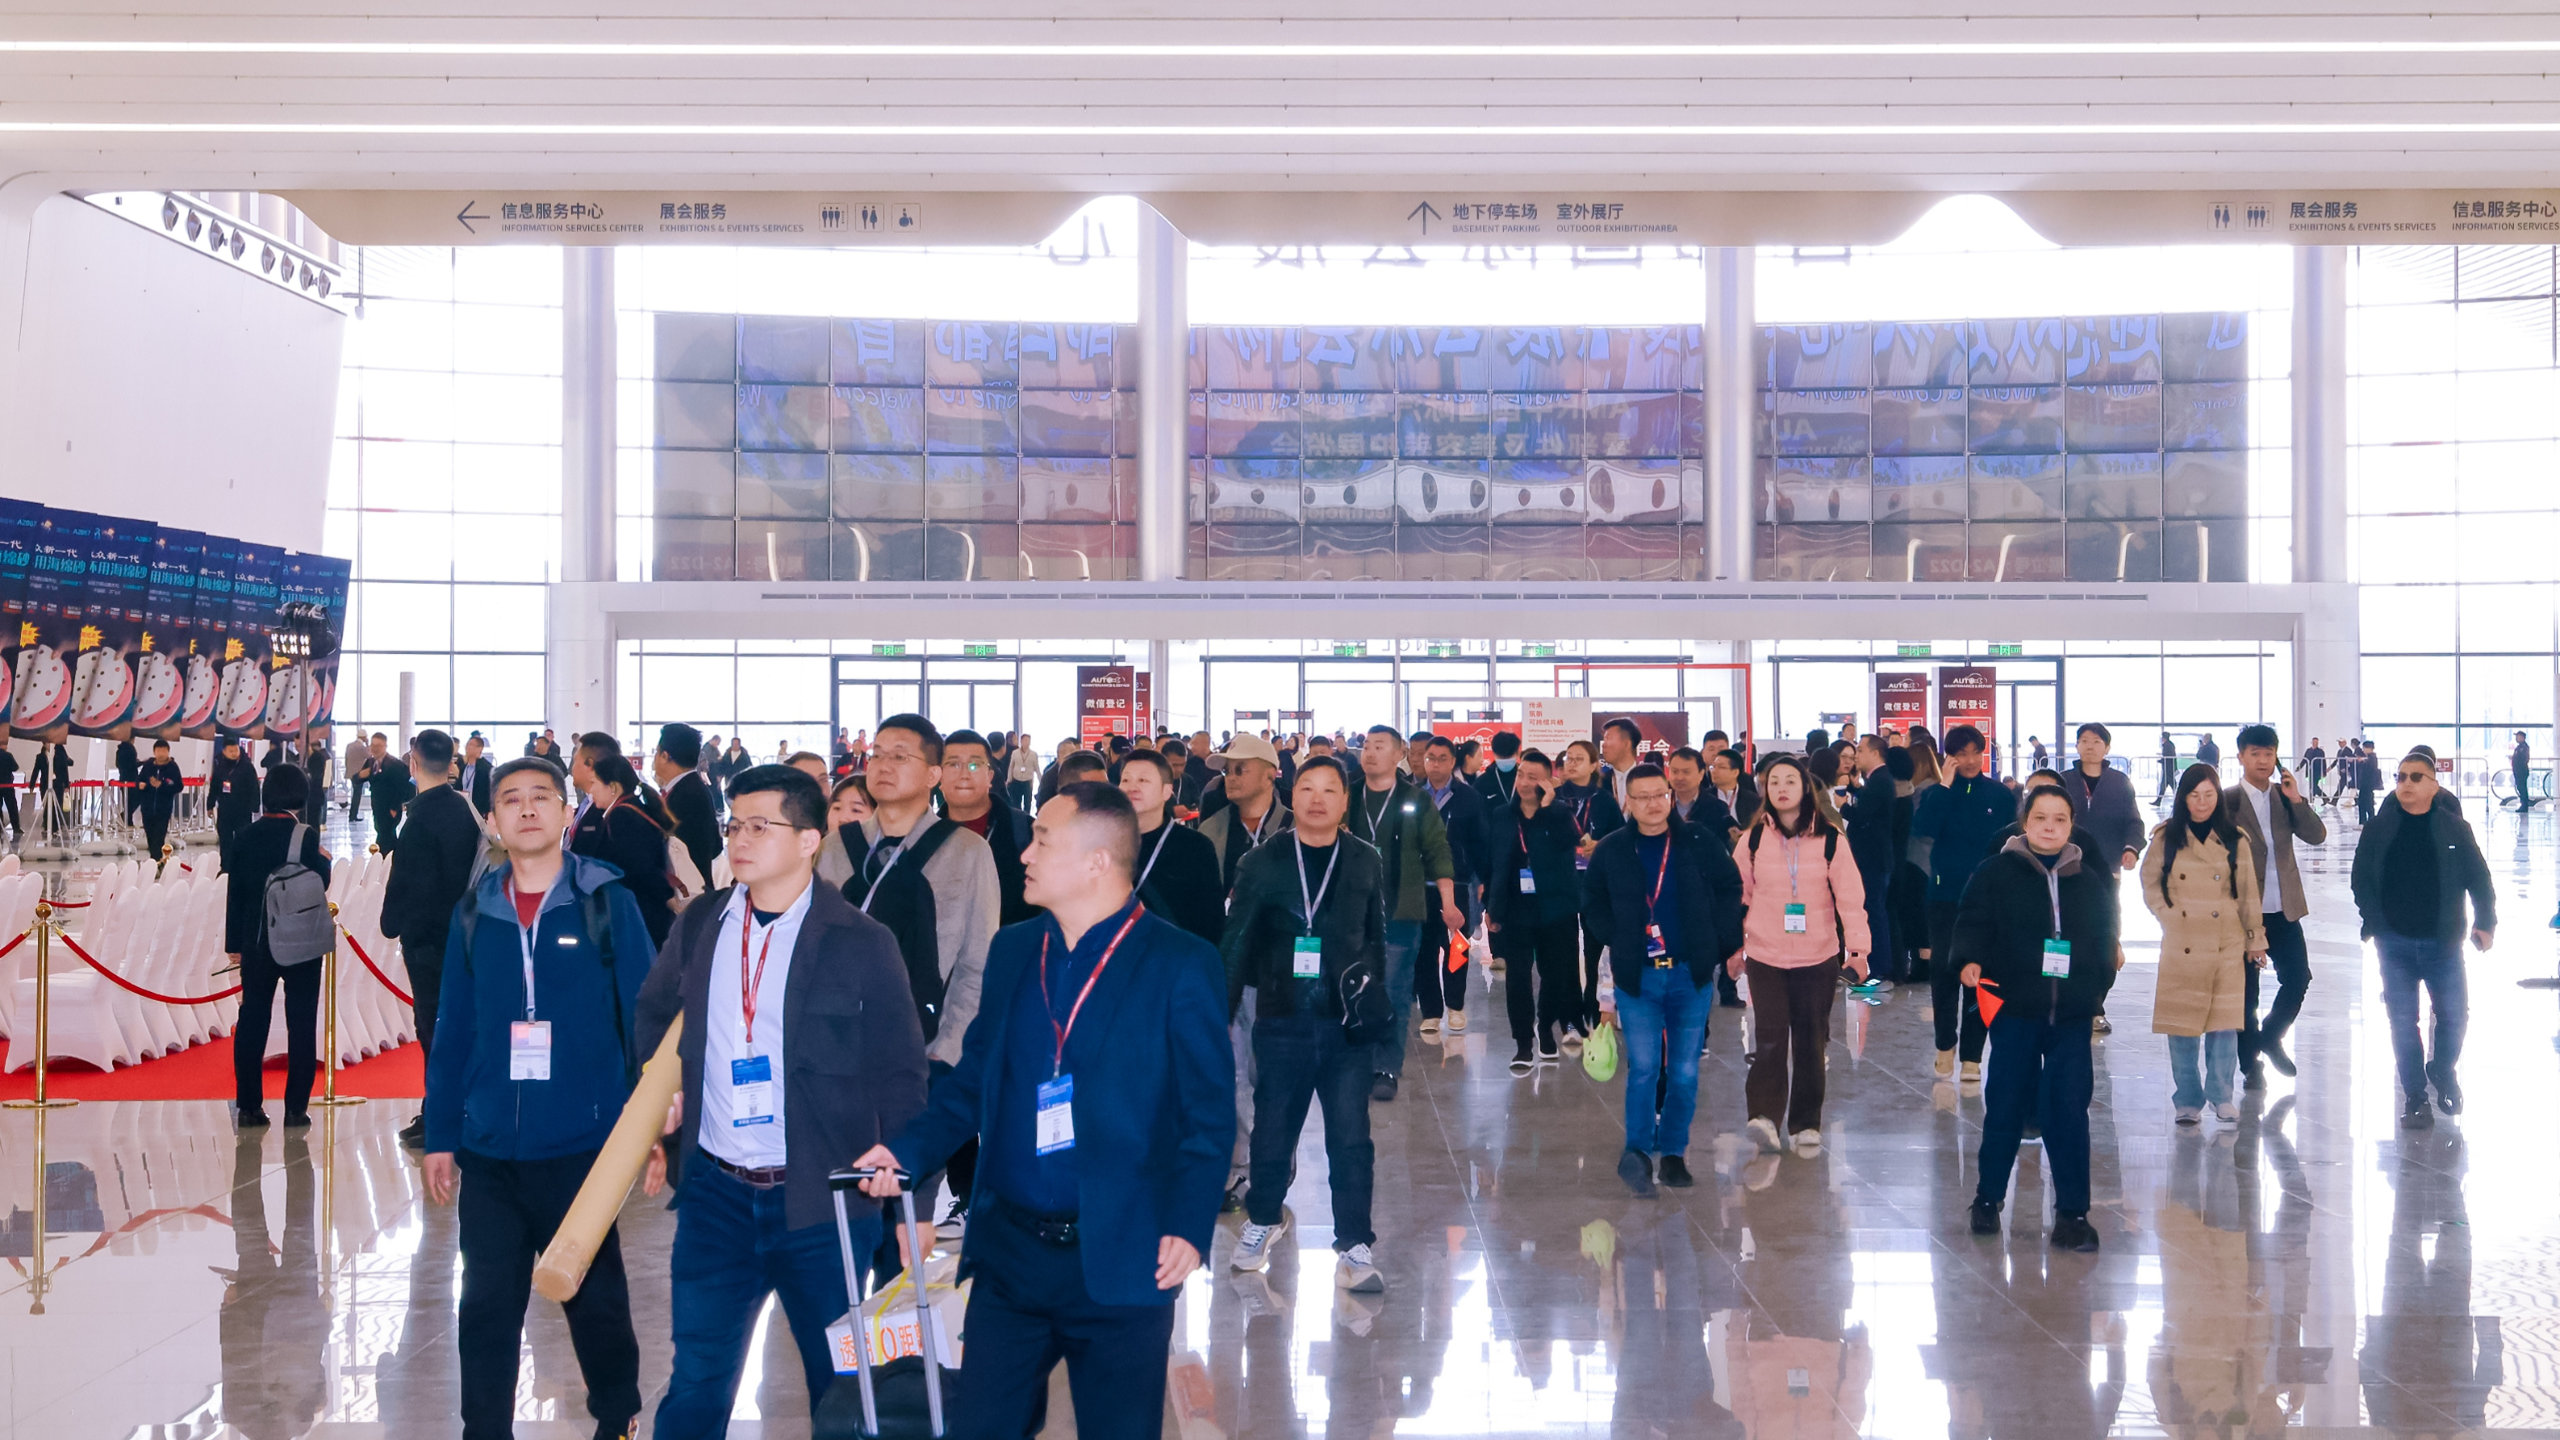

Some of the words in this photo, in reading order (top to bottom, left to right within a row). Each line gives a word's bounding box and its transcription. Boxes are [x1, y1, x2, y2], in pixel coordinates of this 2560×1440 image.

[501, 202, 604, 220] 信息服务中心
[660, 202, 727, 220] 展会服务
[1453, 203, 1538, 220] 地下停车场
[1556, 203, 1624, 220] 室外展厅
[2289, 201, 2358, 219] 展会服务
[2452, 201, 2557, 218] 信息服务中心
[501, 224, 562, 233] INFORMATION
[565, 224, 606, 233] SERVICES
[608, 224, 644, 233] CENTER
[659, 224, 716, 233] EXHIBITIONS
[718, 224, 724, 233] &
[726, 224, 760, 233] EVENTS
[762, 224, 805, 233] SERVICES
[1452, 225, 1499, 233] BASEMENT
[1502, 225, 1541, 233] PARKING
[1556, 225, 1602, 233] OUTDOOR
[2289, 224, 2346, 232] EXHIBITIONS
[2348, 224, 2355, 232] &
[2394, 223, 2437, 231] SERVICES
[2452, 223, 2515, 231] INFORMATION
[2518, 223, 2560, 231] SERVICES
[197, 575, 232, 592] 海绵砂
[1085, 698, 1126, 709] 微信登记
[1884, 702, 1920, 711] 微信登记
[1948, 699, 1988, 710] 微信登记
